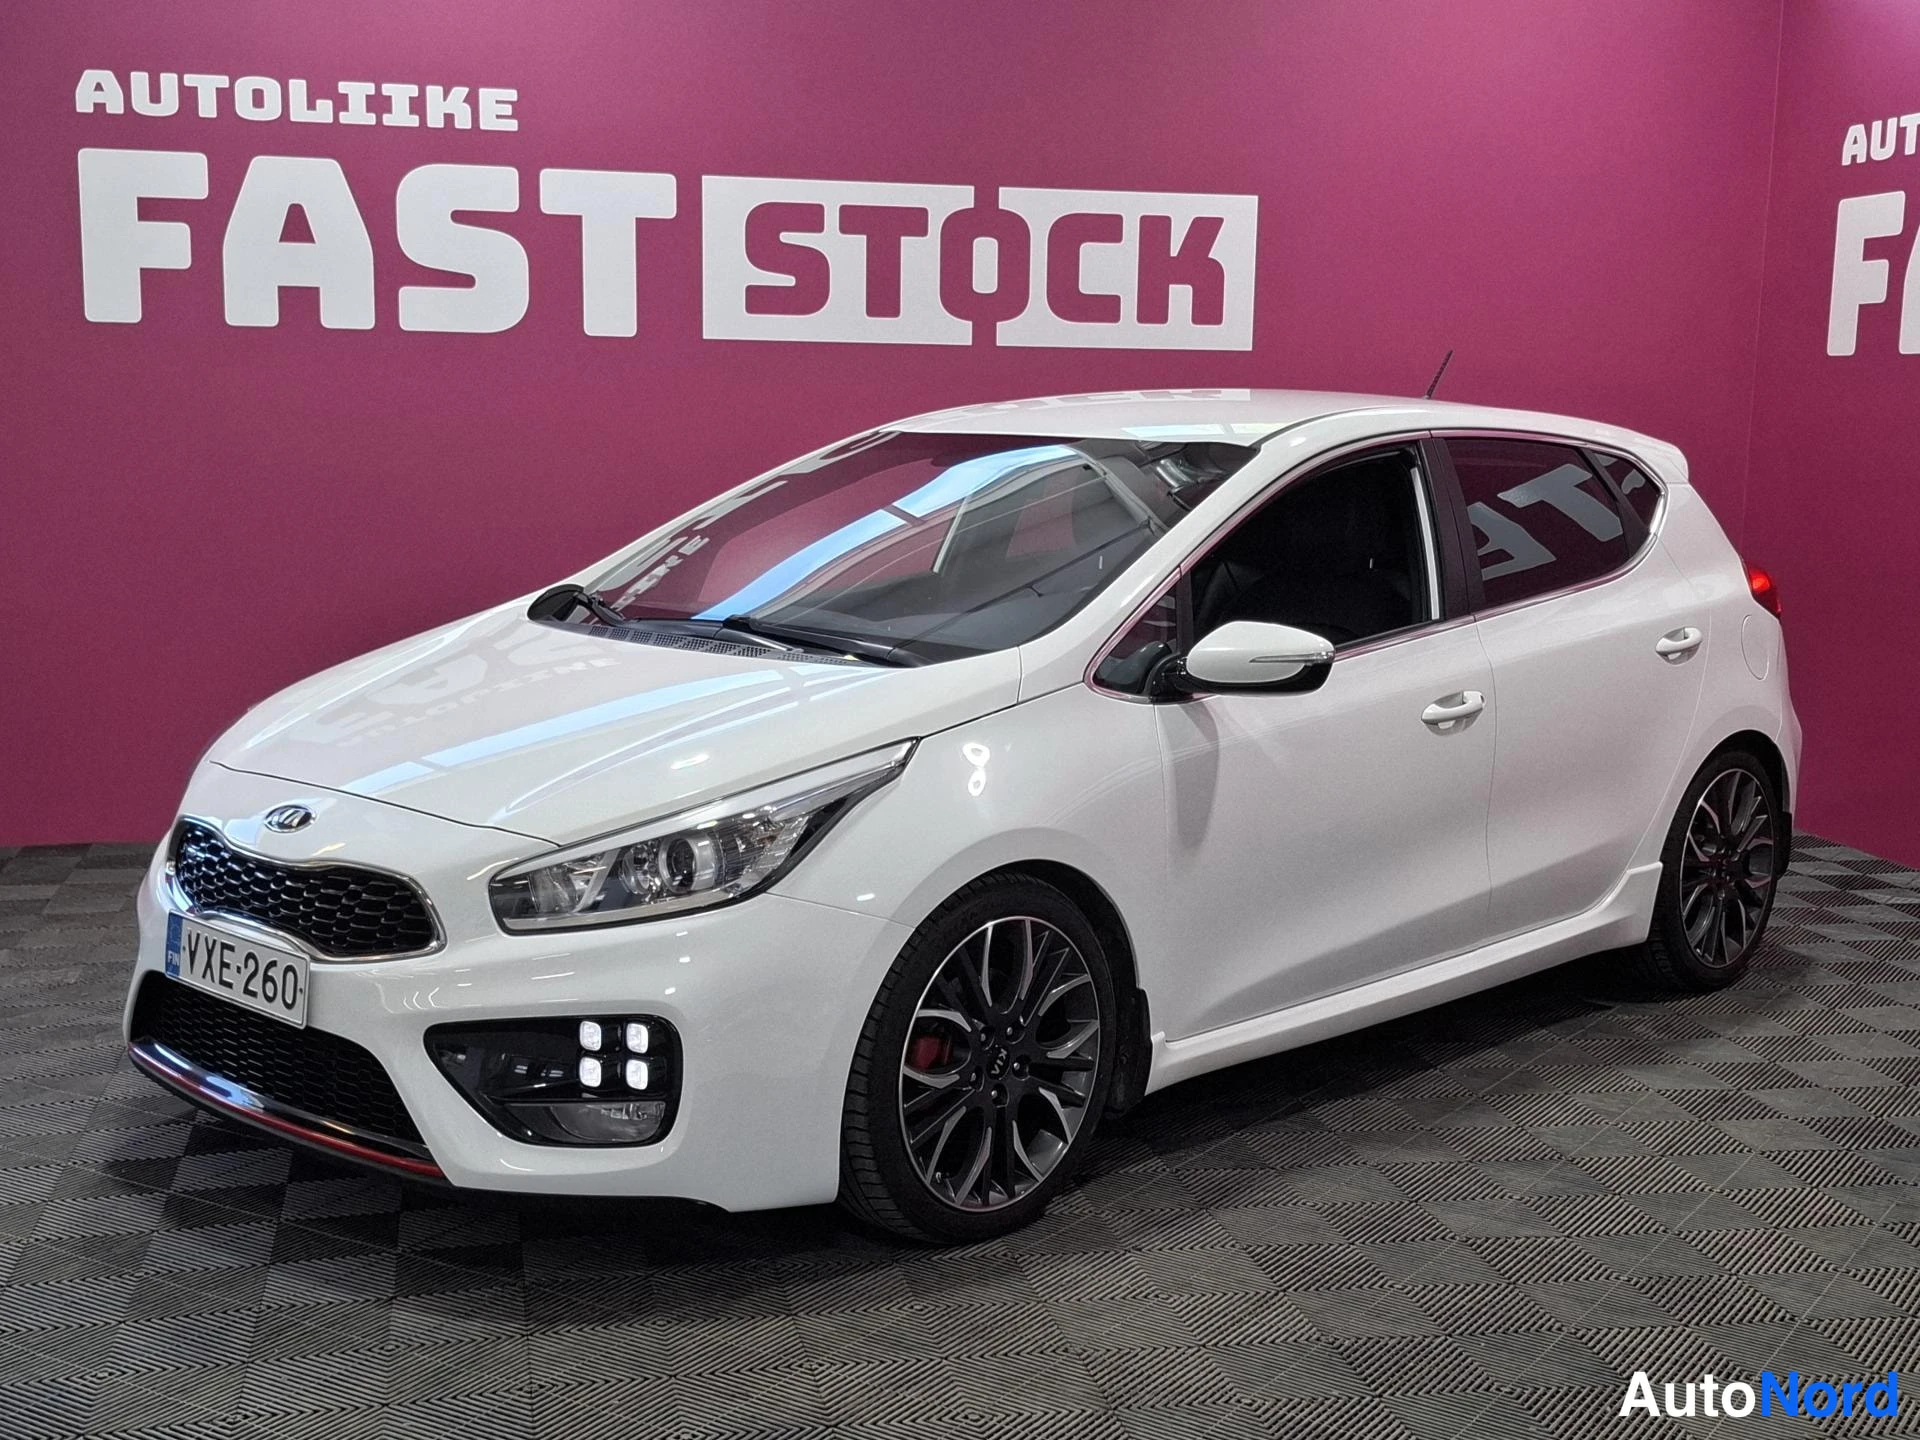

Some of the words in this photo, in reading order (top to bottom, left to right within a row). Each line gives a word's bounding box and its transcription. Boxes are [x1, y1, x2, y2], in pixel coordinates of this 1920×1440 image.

[75, 69, 520, 132] AUTOLIIKE
[77, 147, 678, 338] FAST
[744, 200, 1226, 327] STOCK
[1826, 190, 1920, 357] F
[167, 950, 181, 968] FIN
[187, 929, 299, 1011] VXE-260
[990, 1048, 1008, 1075] KIA
